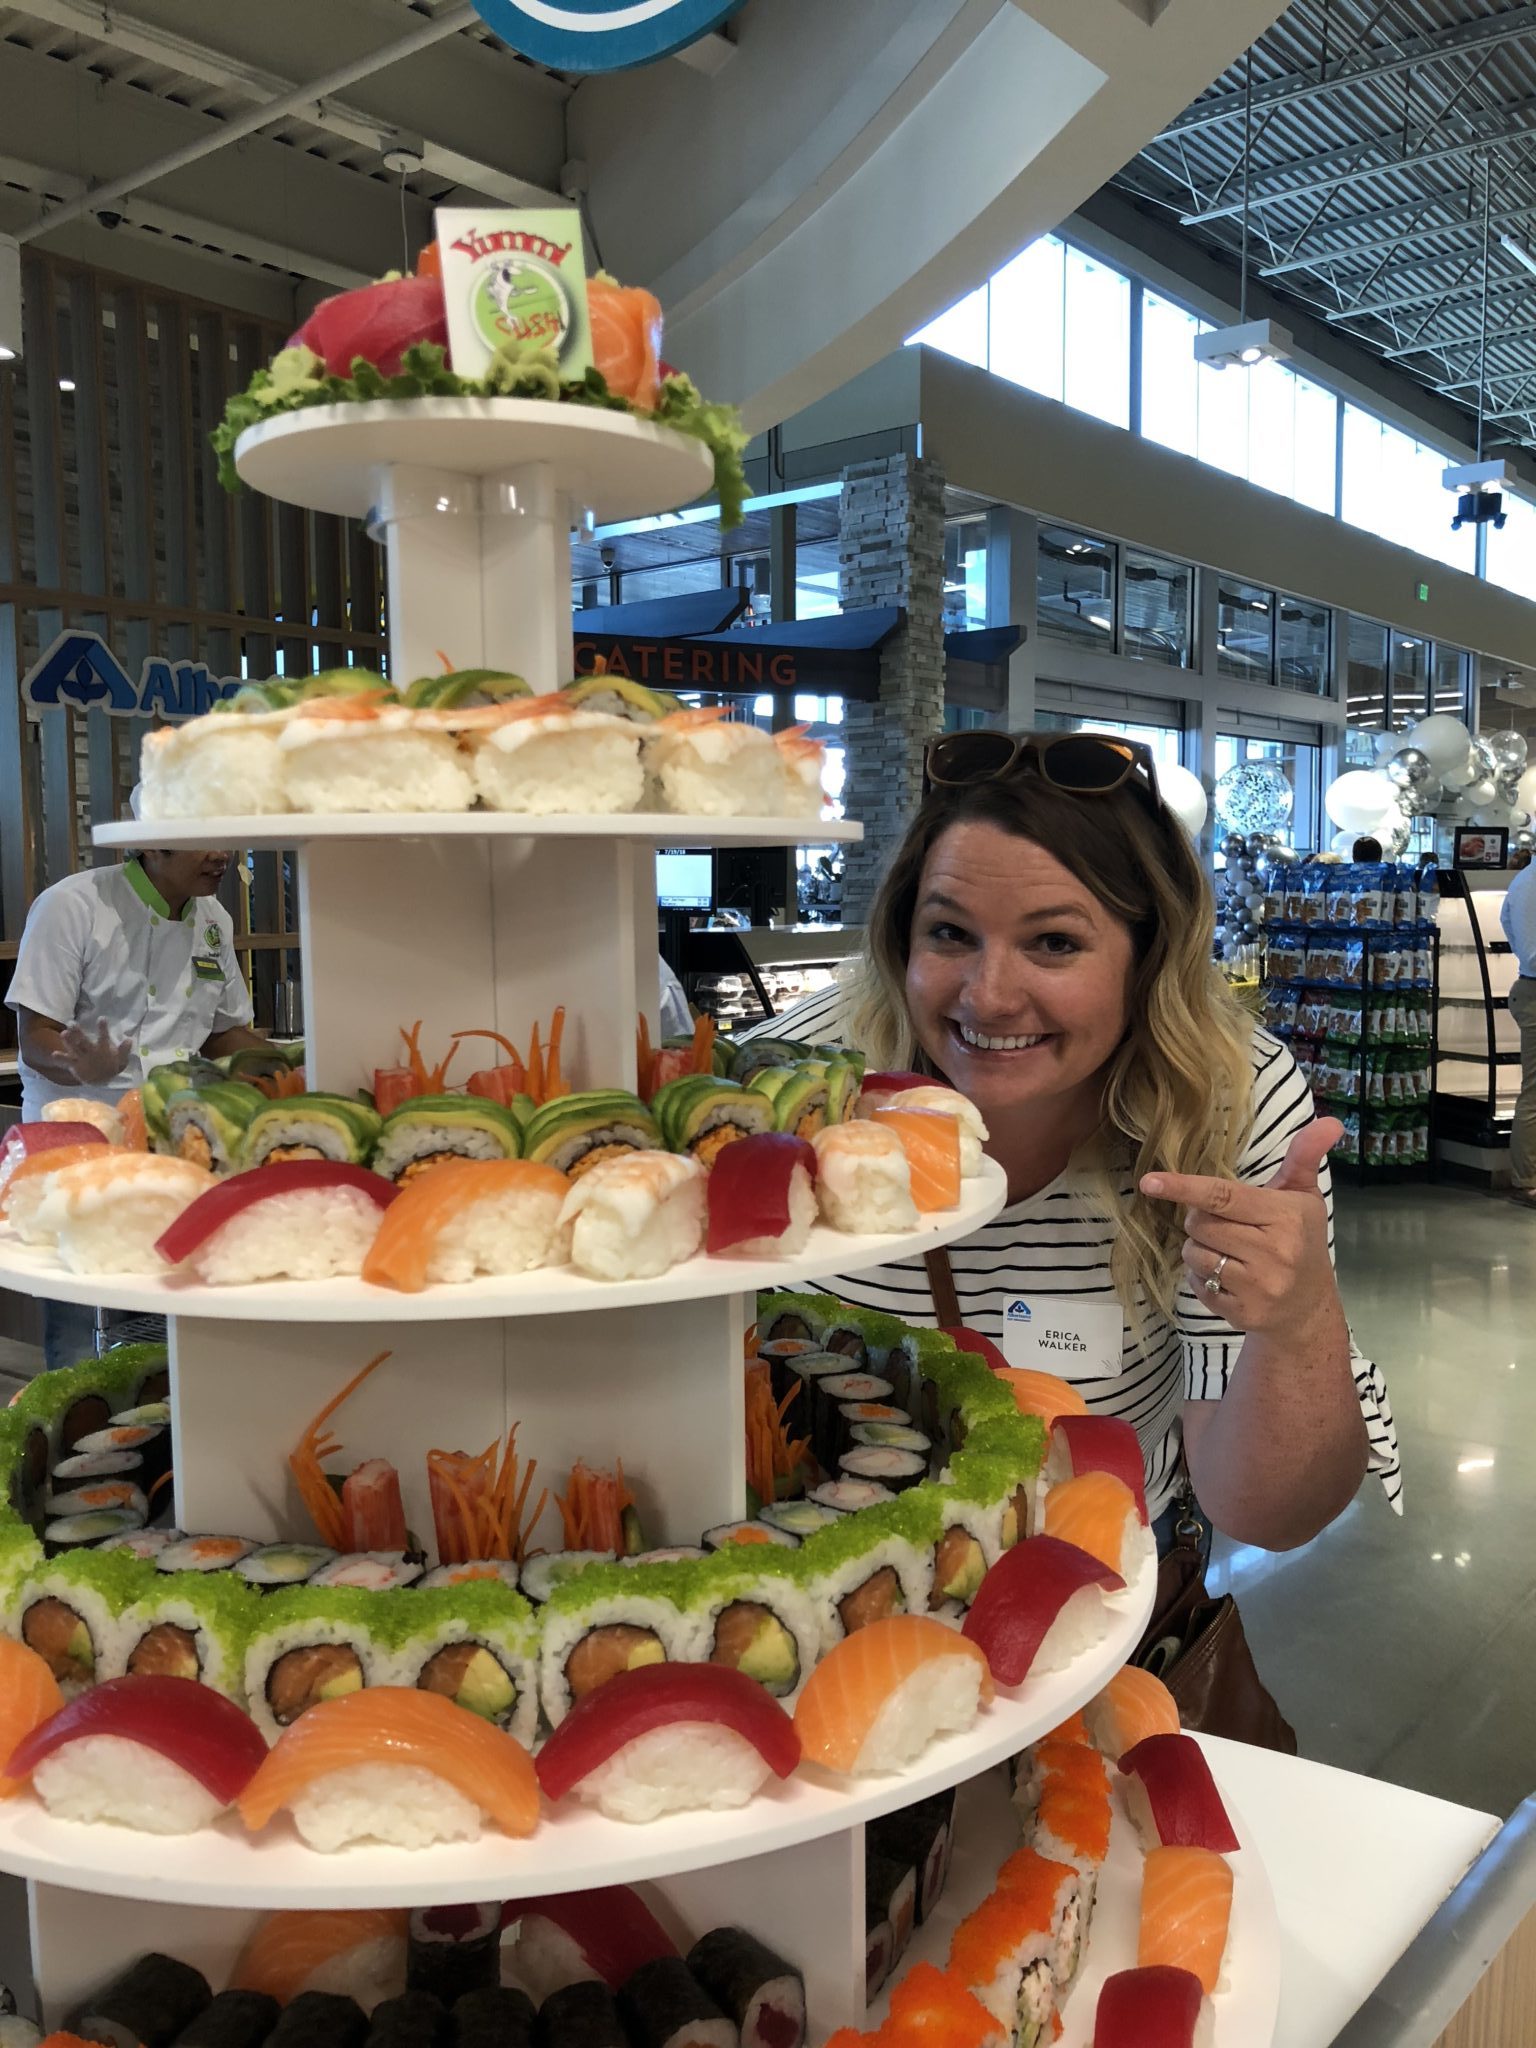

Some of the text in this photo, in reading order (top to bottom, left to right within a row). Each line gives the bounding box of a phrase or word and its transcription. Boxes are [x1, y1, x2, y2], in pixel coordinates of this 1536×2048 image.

[574, 641, 797, 686] CATERING
[1045, 1330, 1081, 1342] ERICA
[1038, 1339, 1087, 1352] WALKER
